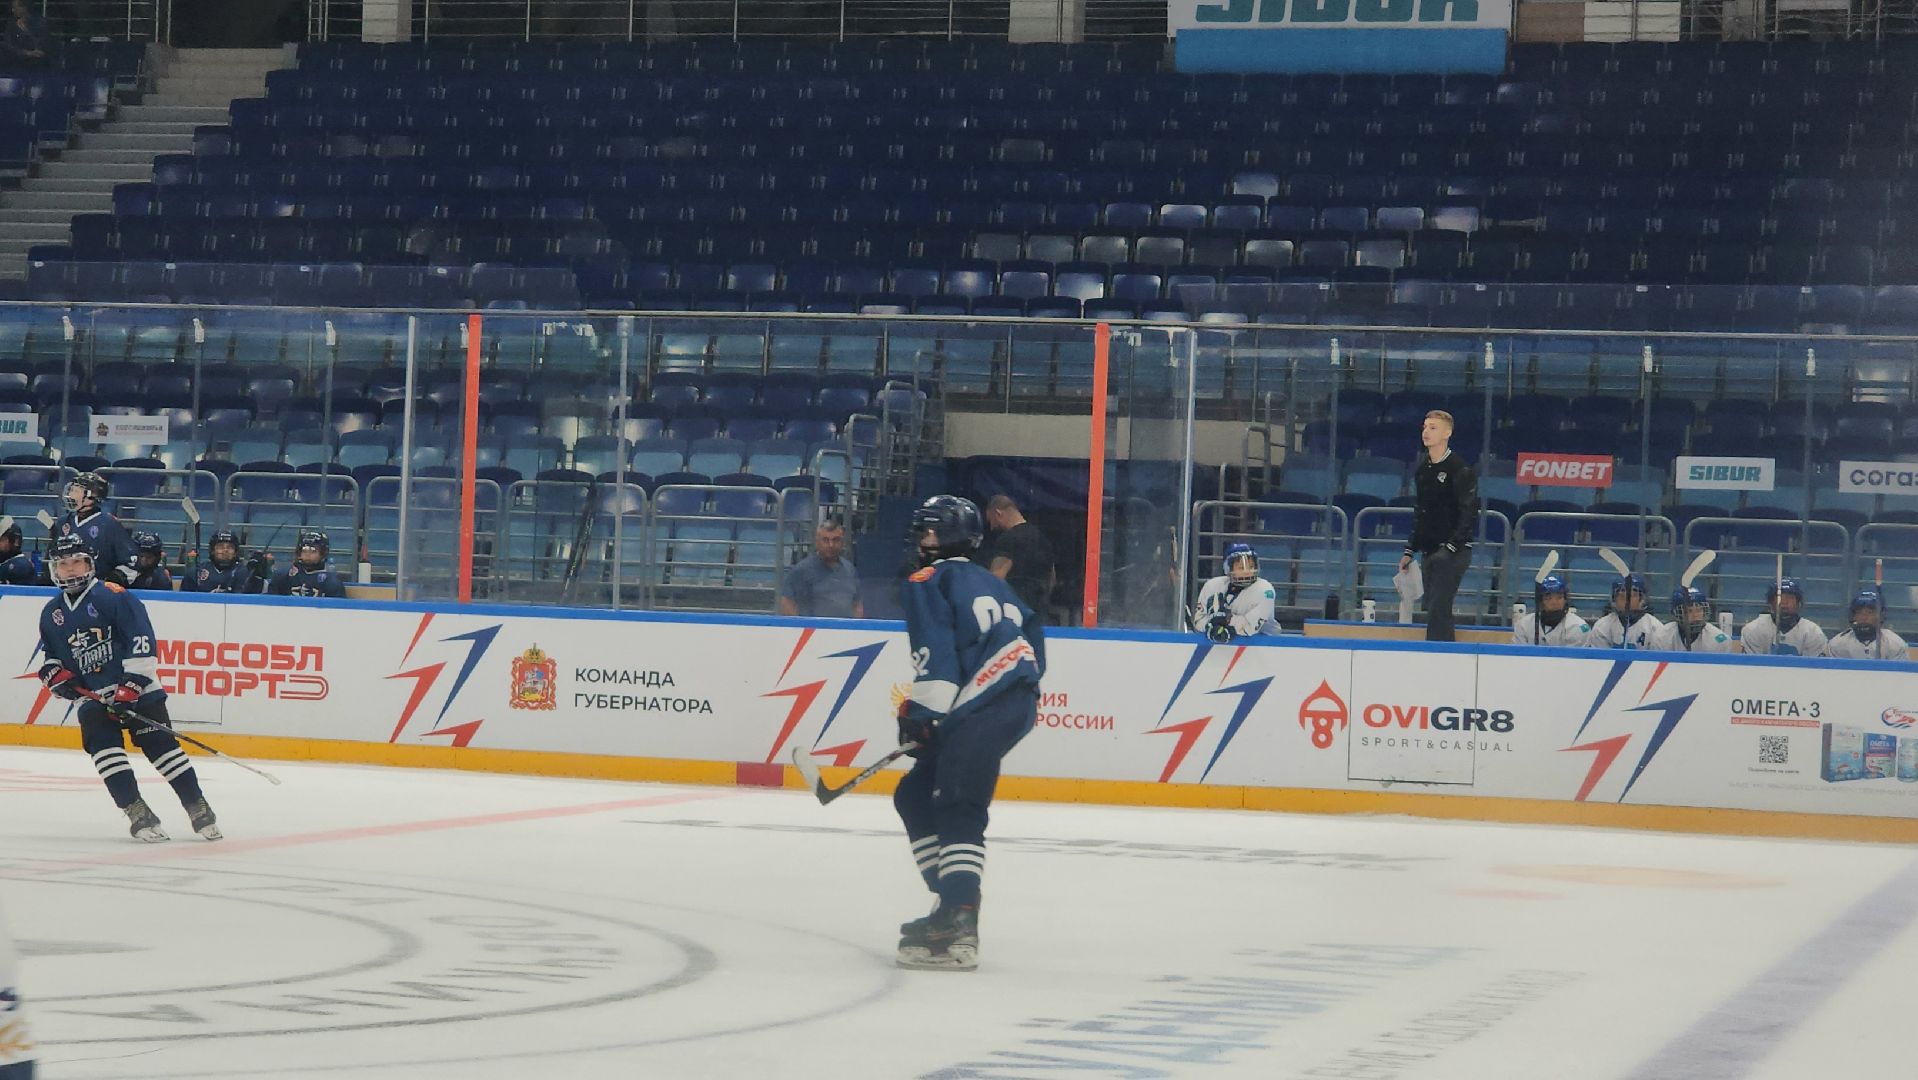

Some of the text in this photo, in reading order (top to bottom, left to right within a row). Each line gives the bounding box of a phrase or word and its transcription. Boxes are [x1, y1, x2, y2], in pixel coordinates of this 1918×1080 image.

[1519, 458, 1611, 480] FONBET
[1689, 465, 1761, 482] SIBUR
[132, 635, 150, 654] 26
[156, 669, 286, 698] СПОРТ
[575, 668, 675, 688] КОМАНДА
[574, 693, 713, 714] ГУБЕРНАТОРА
[1035, 712, 1114, 730] РОССИИ
[1362, 703, 1515, 733] OVIGR8
